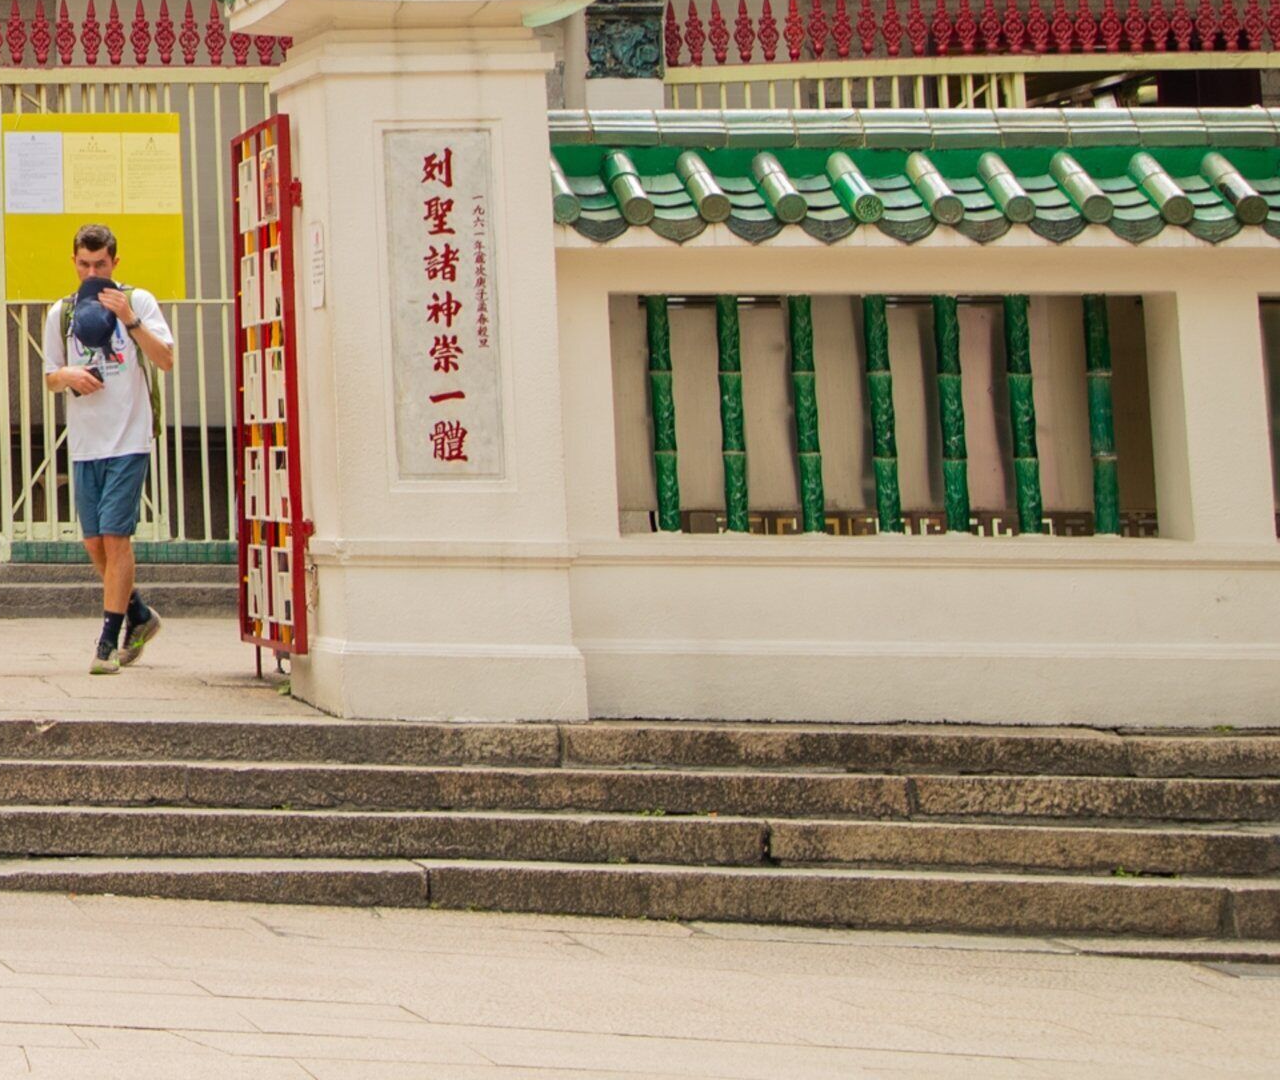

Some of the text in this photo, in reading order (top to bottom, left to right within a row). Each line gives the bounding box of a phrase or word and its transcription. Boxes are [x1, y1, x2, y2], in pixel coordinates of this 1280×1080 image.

[421, 147, 469, 463] 列聖諸神崇一體
